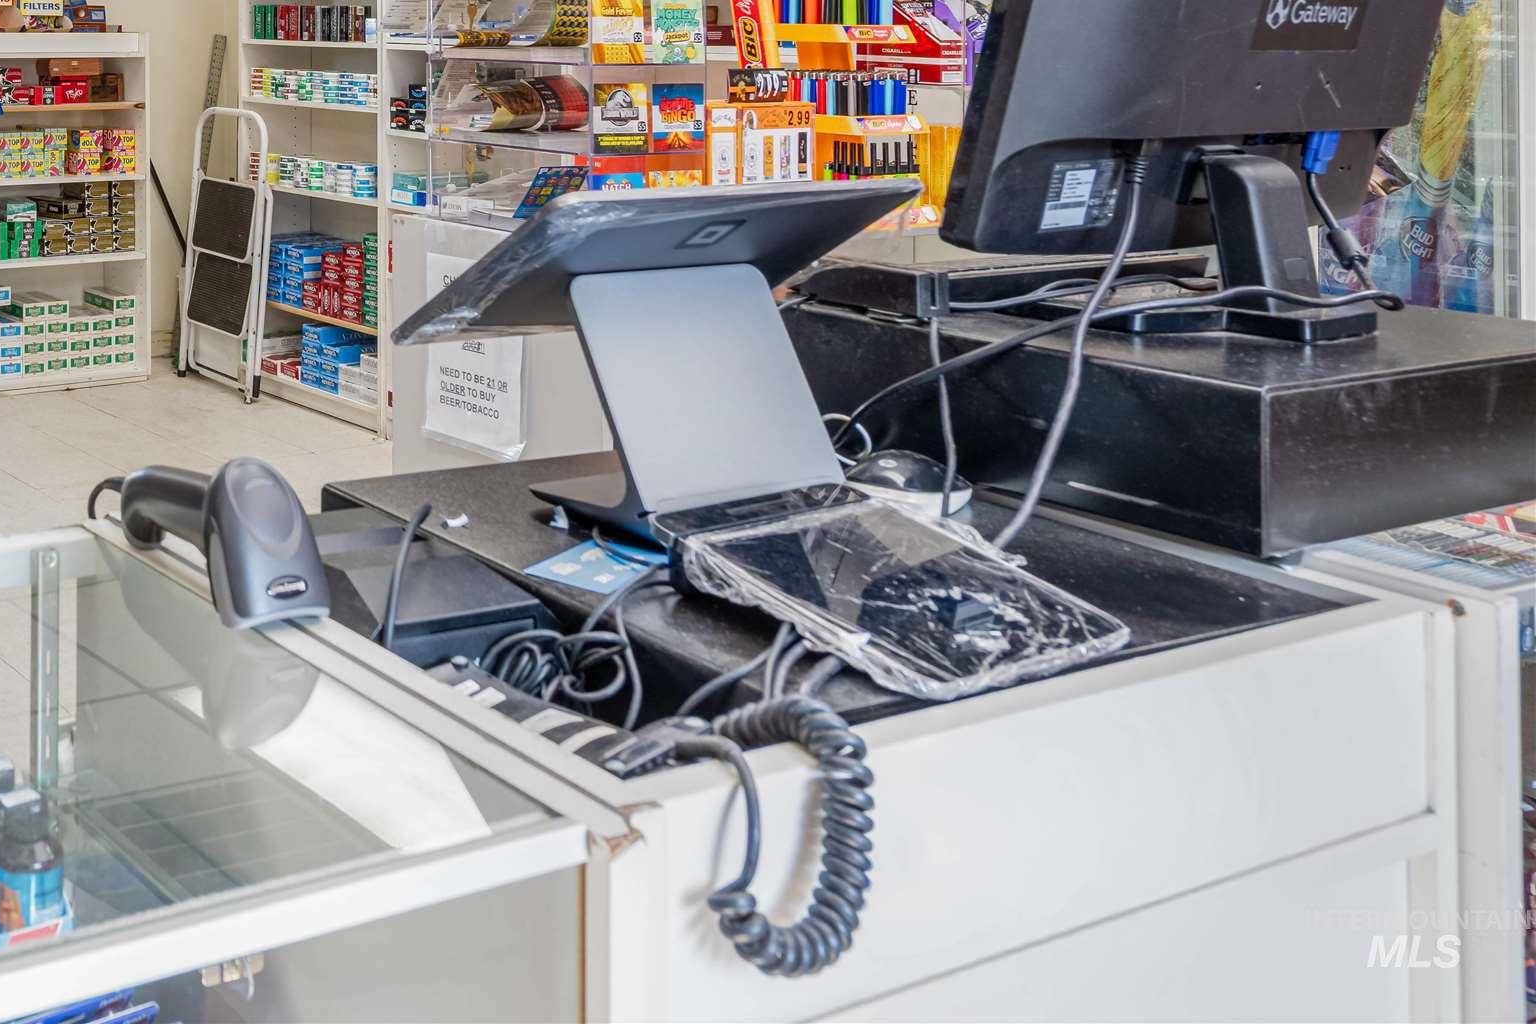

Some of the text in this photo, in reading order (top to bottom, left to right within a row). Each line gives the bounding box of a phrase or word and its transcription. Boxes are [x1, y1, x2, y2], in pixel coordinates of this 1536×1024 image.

[23, 2, 60, 11] FILTERS
[660, 109, 696, 123] BINGO
[787, 110, 811, 126] 2.99
[1411, 225, 1435, 246] BUD
[1403, 235, 1435, 259] LIGHT
[439, 366, 508, 392] NEED TO BE 21 OR
[440, 381, 496, 403] OLDER TO BUY
[440, 395, 500, 419] BEER/TOBACCO
